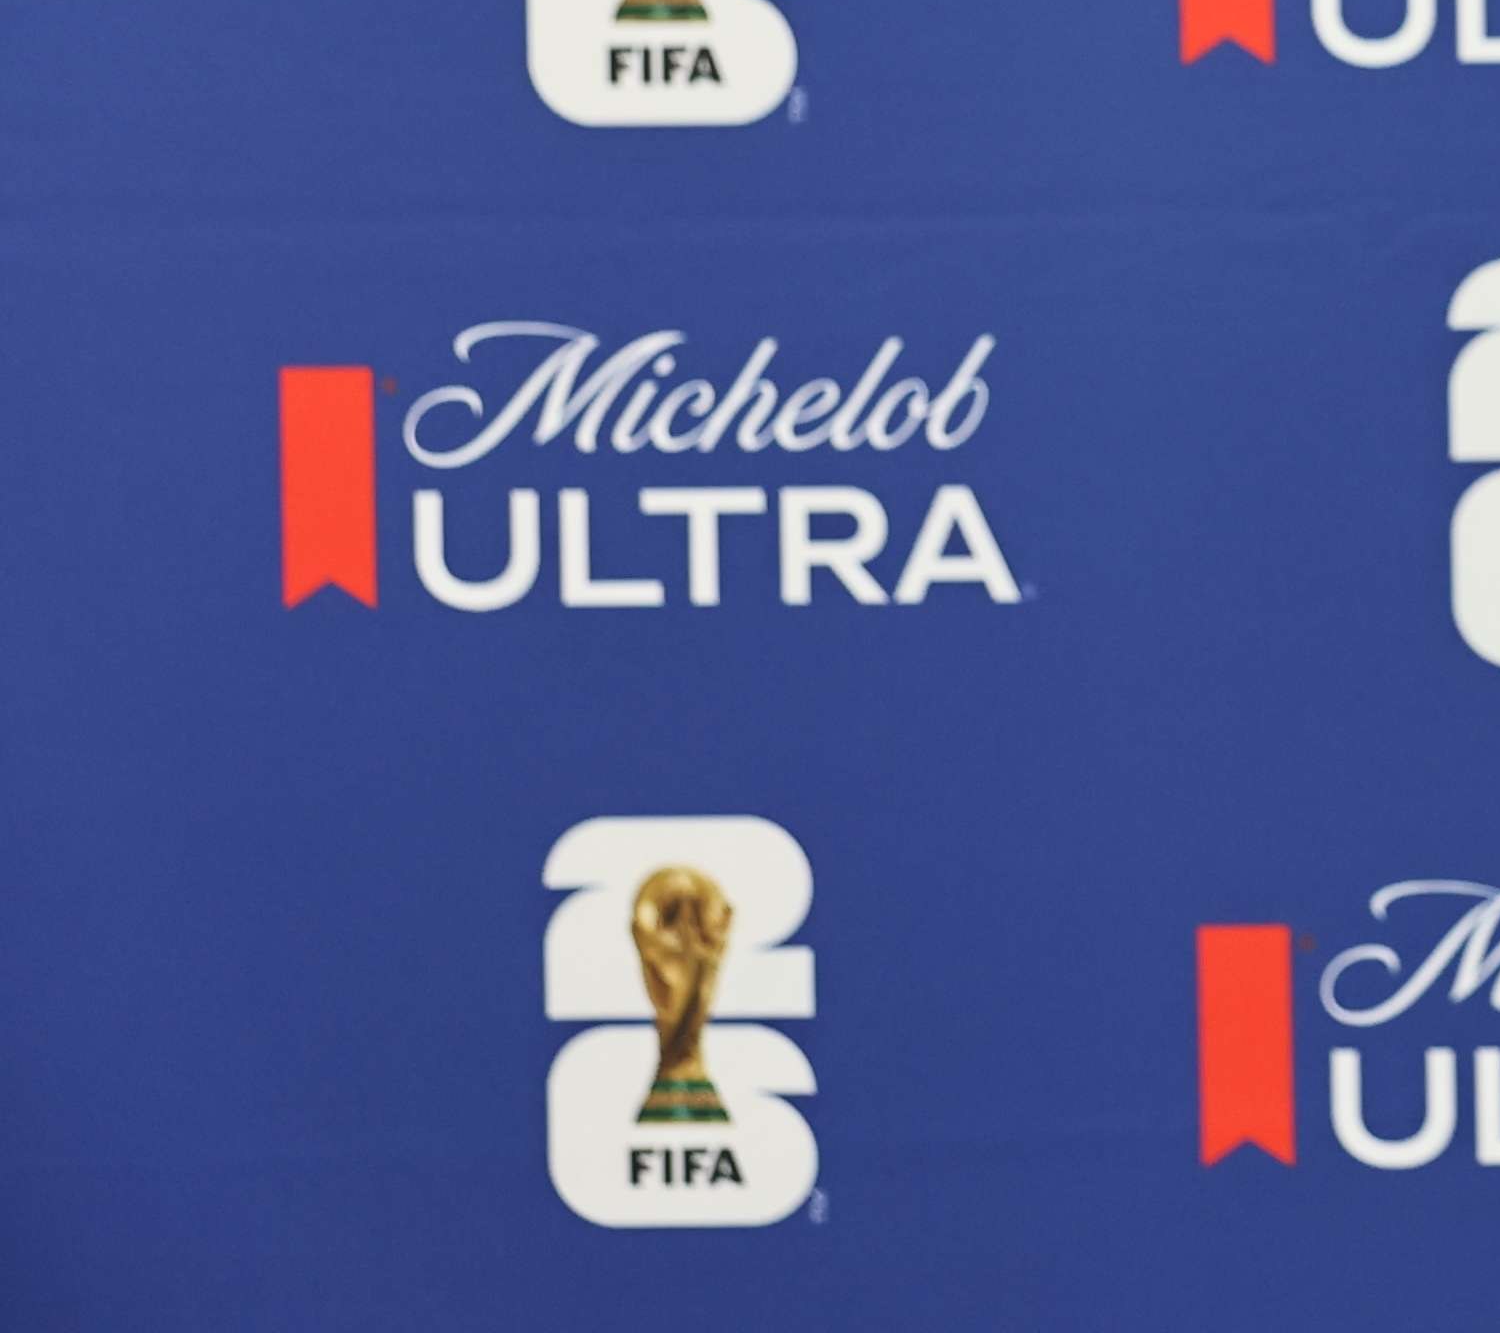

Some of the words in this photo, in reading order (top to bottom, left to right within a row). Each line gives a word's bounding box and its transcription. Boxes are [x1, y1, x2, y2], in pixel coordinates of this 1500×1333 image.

[607, 44, 723, 86] FIFA
[401, 319, 997, 471] Michelob
[411, 483, 1023, 614] ULTRA
[627, 1146, 745, 1188] FIFA
